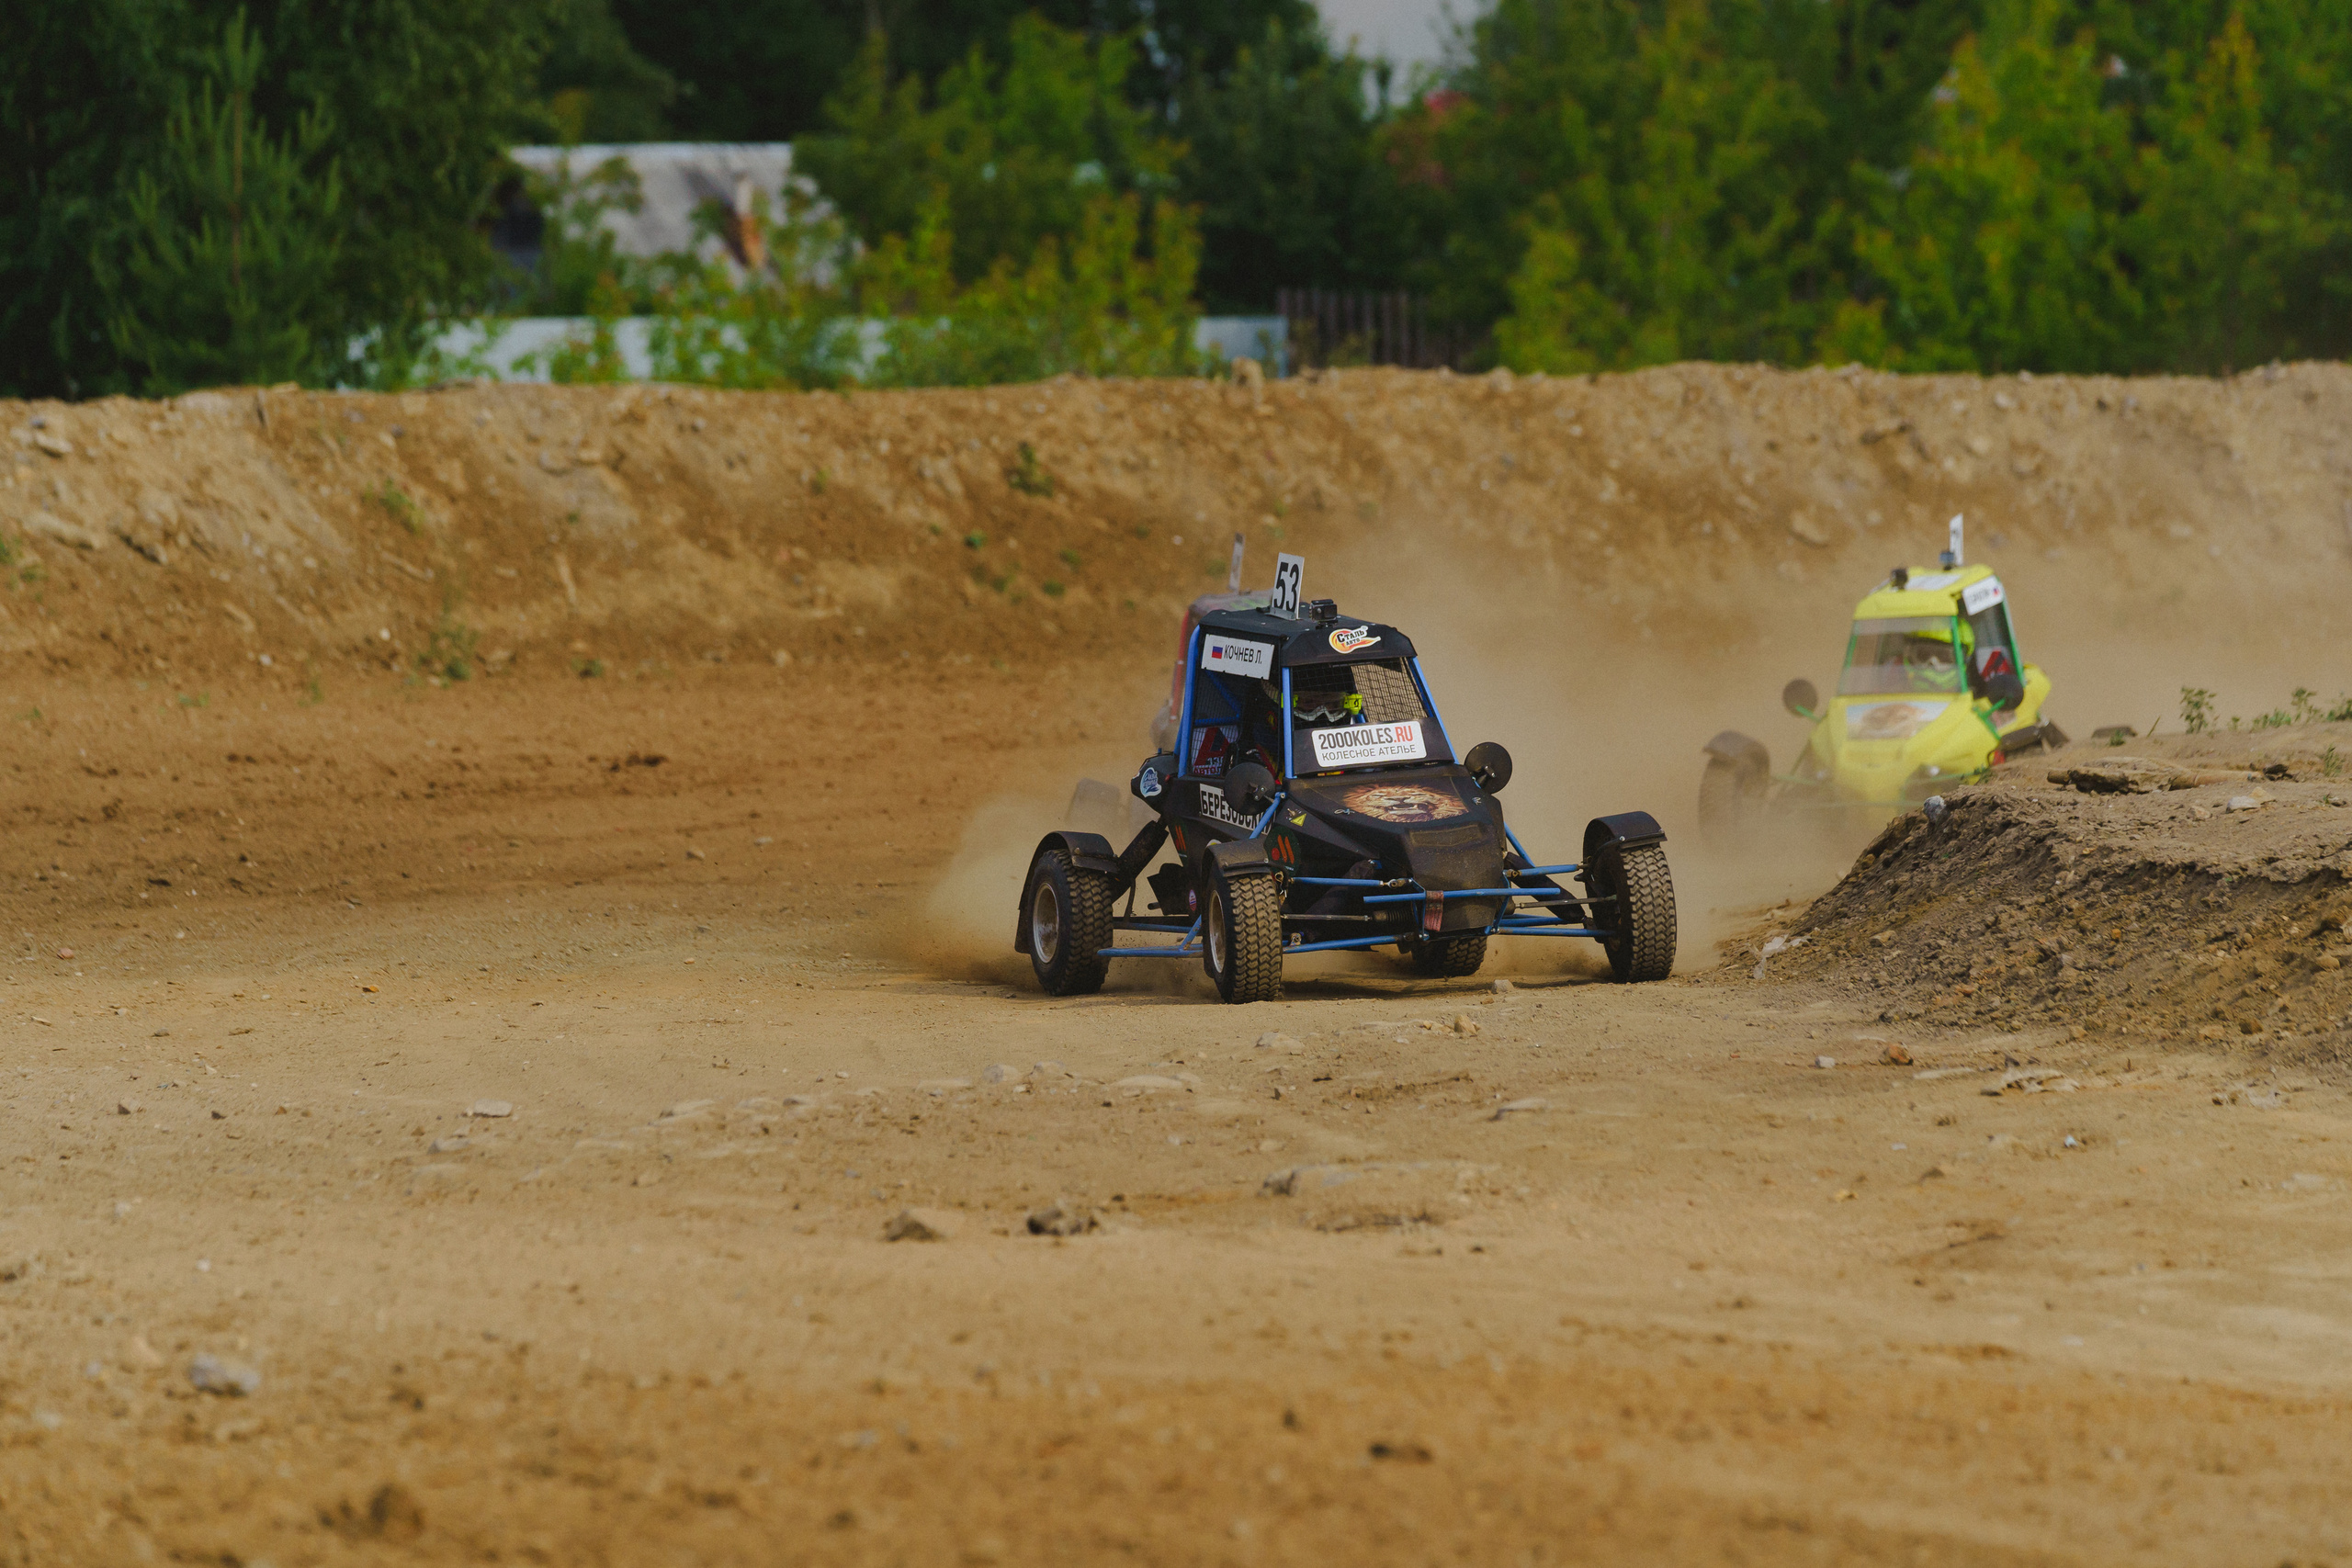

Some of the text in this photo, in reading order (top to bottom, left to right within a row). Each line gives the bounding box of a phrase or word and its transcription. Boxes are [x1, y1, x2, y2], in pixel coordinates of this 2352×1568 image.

[1273, 561, 1300, 613] 53
[1224, 644, 1262, 664] КОЧНЕВ Л.
[1318, 725, 1414, 750] 2000KOLES.RU
[1322, 744, 1417, 761] КОЛЕСНОЕ АТЕЛЬЕ
